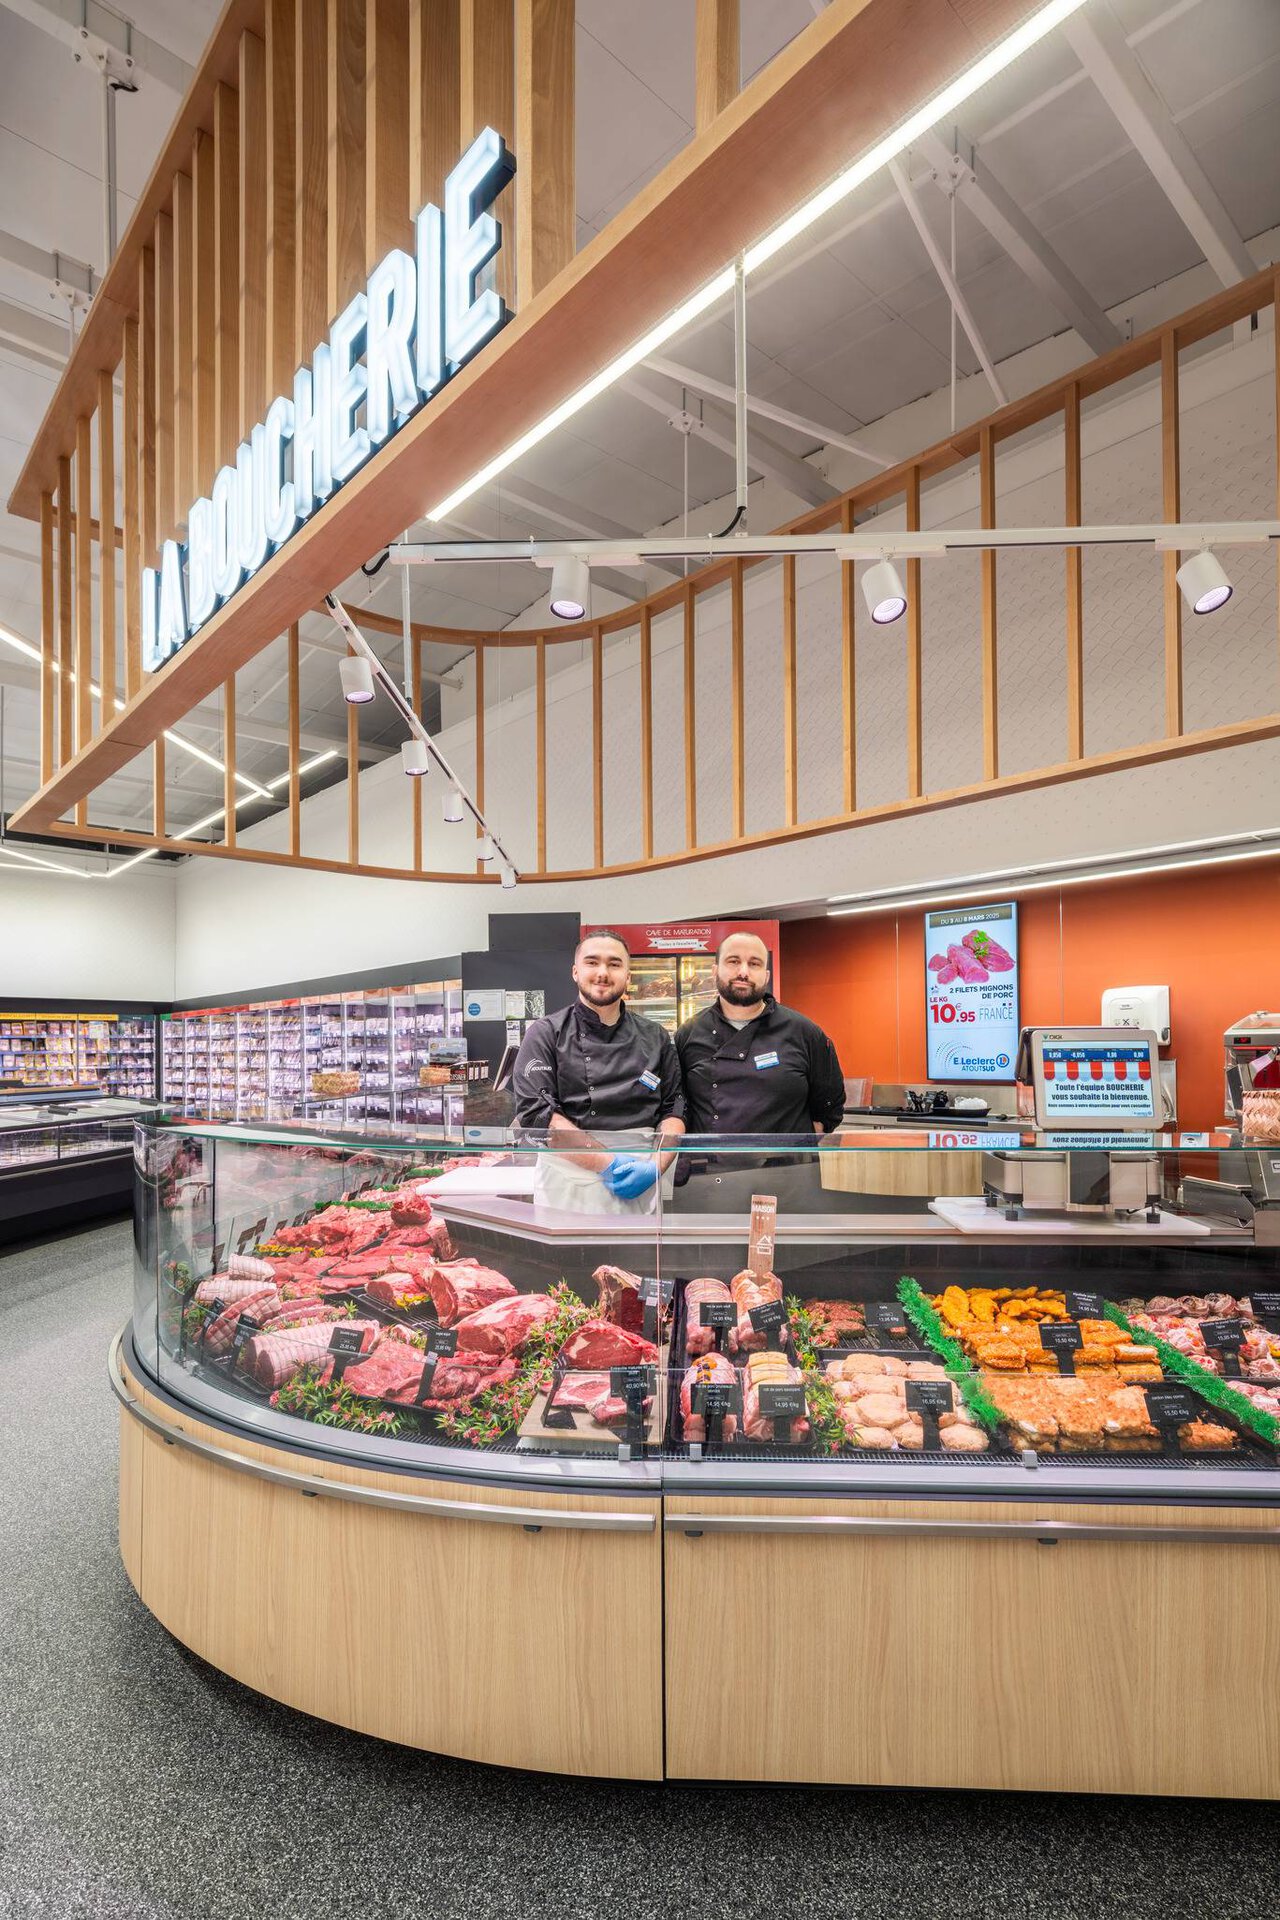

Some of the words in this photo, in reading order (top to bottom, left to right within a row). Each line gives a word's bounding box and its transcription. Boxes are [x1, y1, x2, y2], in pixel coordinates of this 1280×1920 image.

[142, 538, 191, 673] LA
[187, 126, 516, 626] BOUCHERIE
[968, 914, 985, 922] MARS
[645, 929, 662, 937] CAVE
[673, 928, 712, 936] MATURATION
[979, 984, 1014, 992] MIGNONS
[979, 1006, 1013, 1020] FRANCE
[1055, 1083, 1076, 1091] Toute
[1076, 1083, 1105, 1092] l'équipe
[1106, 1083, 1145, 1091] BOUCHERIE
[1070, 1093, 1101, 1101] souhaite
[1102, 1093, 1109, 1101] la
[1110, 1093, 1150, 1101] bienvenue.
[721, 1401, 731, 1409] €/kg
[789, 1401, 800, 1409] €/kg
[1163, 1409, 1179, 1417] 15,50
[1178, 1408, 1190, 1416] €/kg
